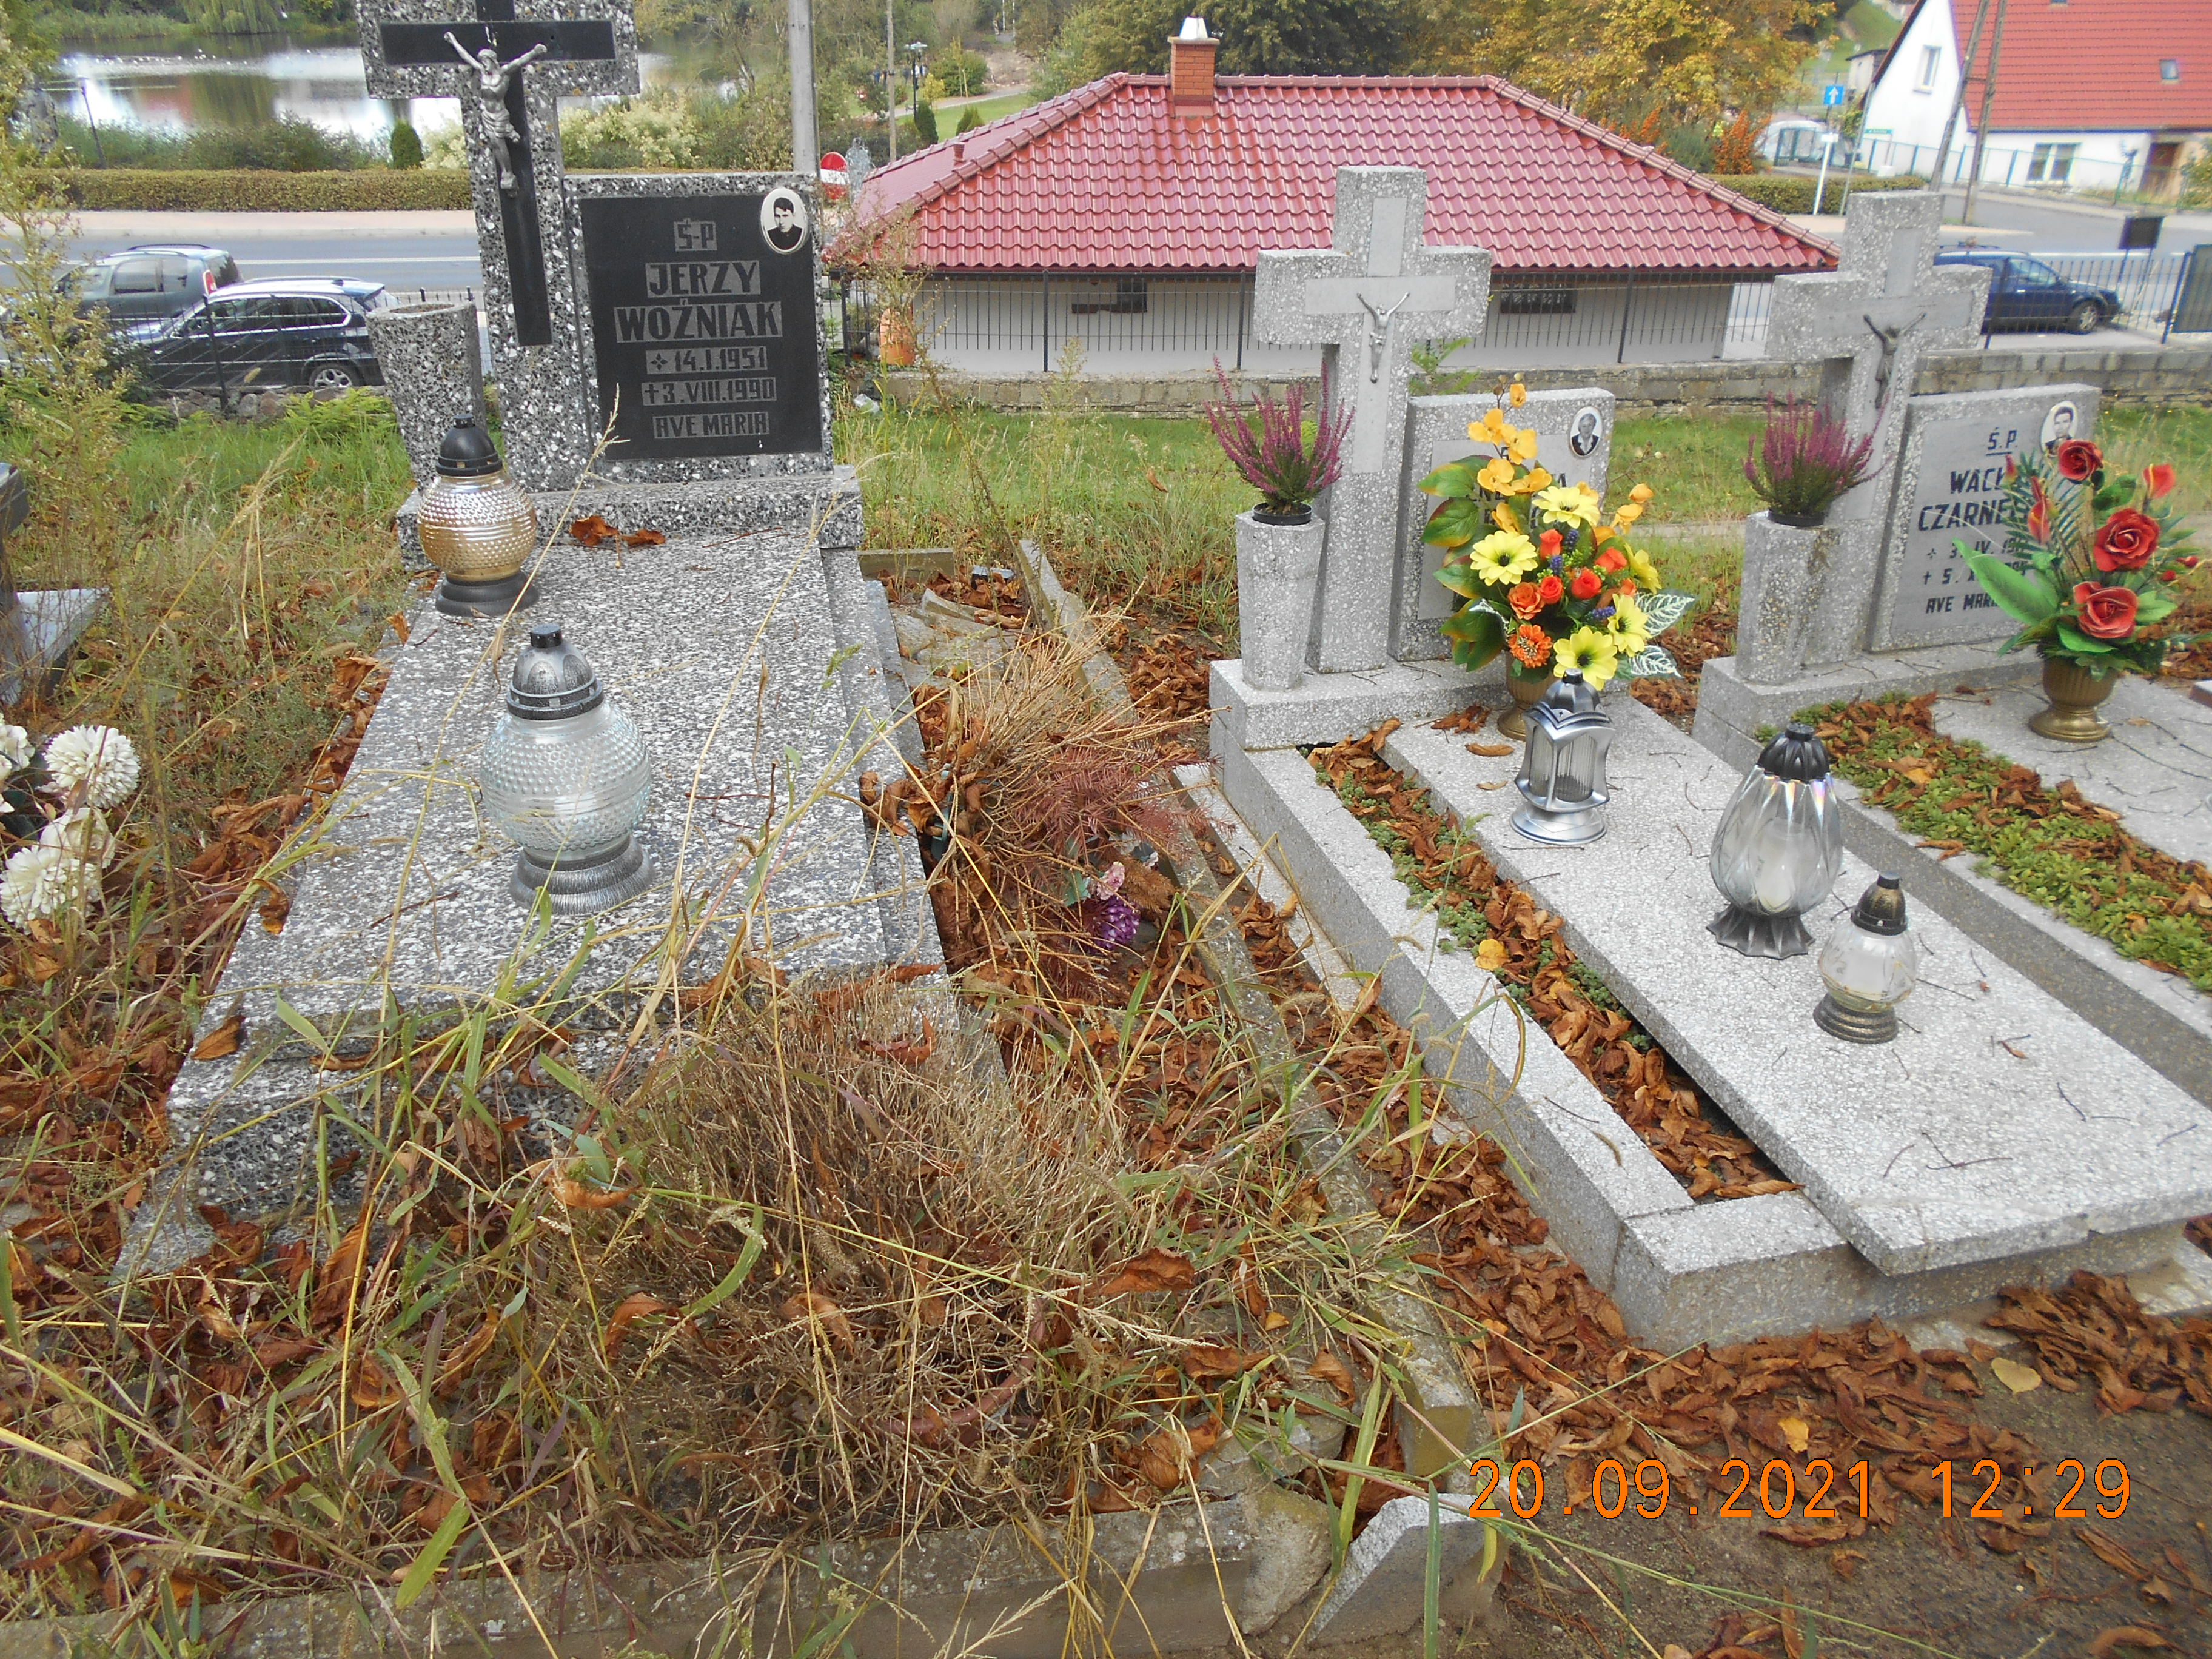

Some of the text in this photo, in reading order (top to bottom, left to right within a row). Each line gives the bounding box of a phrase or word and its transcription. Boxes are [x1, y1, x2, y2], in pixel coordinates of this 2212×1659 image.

[649, 262, 756, 295] JERZY
[617, 299, 779, 341] WOŹNIAK
[655, 413, 767, 437] AVE MARIA
[1926, 592, 1998, 614] AVE MAR
